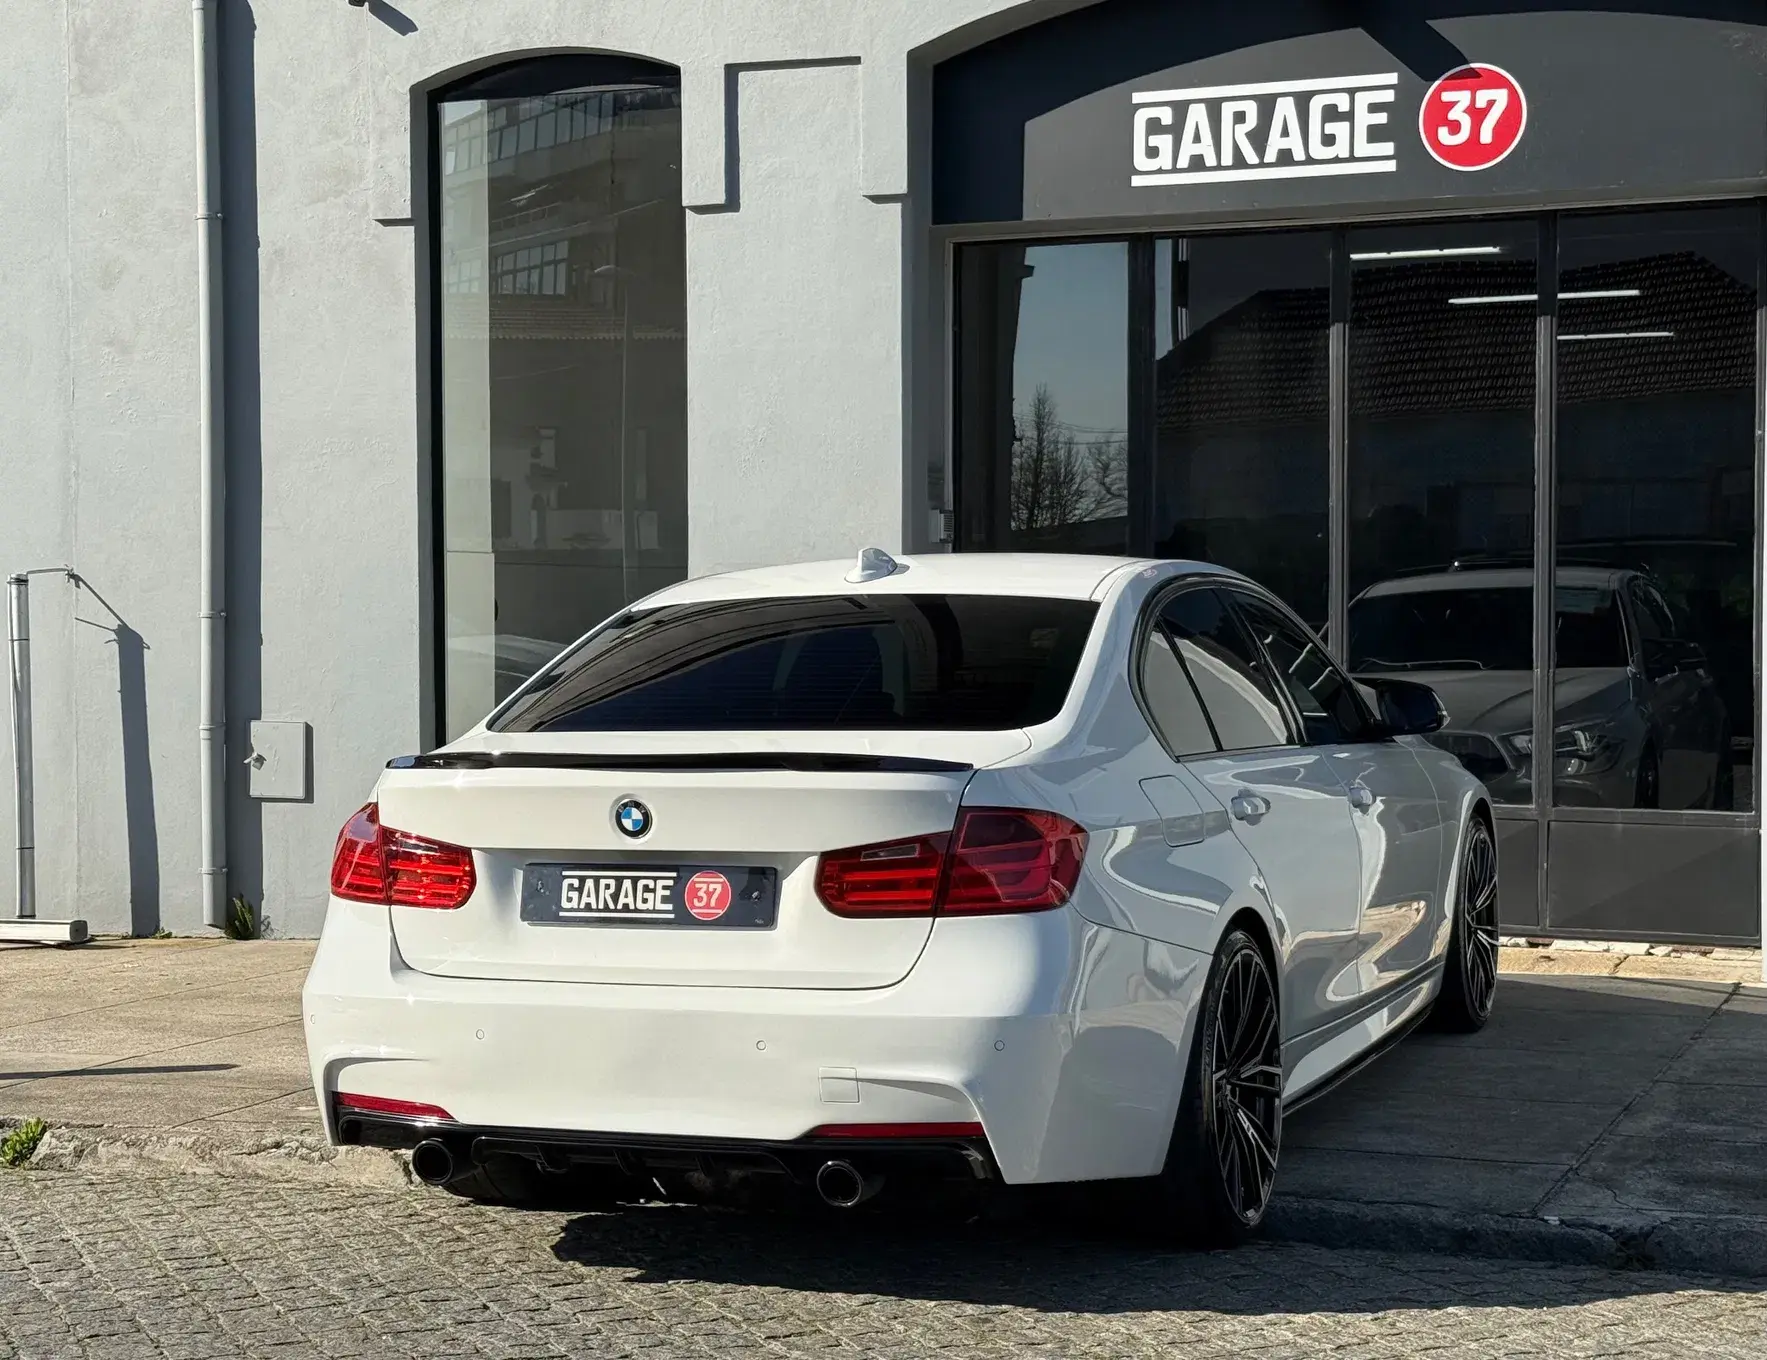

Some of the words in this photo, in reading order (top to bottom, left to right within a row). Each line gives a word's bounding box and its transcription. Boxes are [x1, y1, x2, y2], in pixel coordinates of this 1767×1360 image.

[1132, 89, 1396, 172] GARAGE
[1437, 88, 1509, 146] 37
[560, 878, 675, 911] GARAGE
[693, 883, 723, 908] 37
